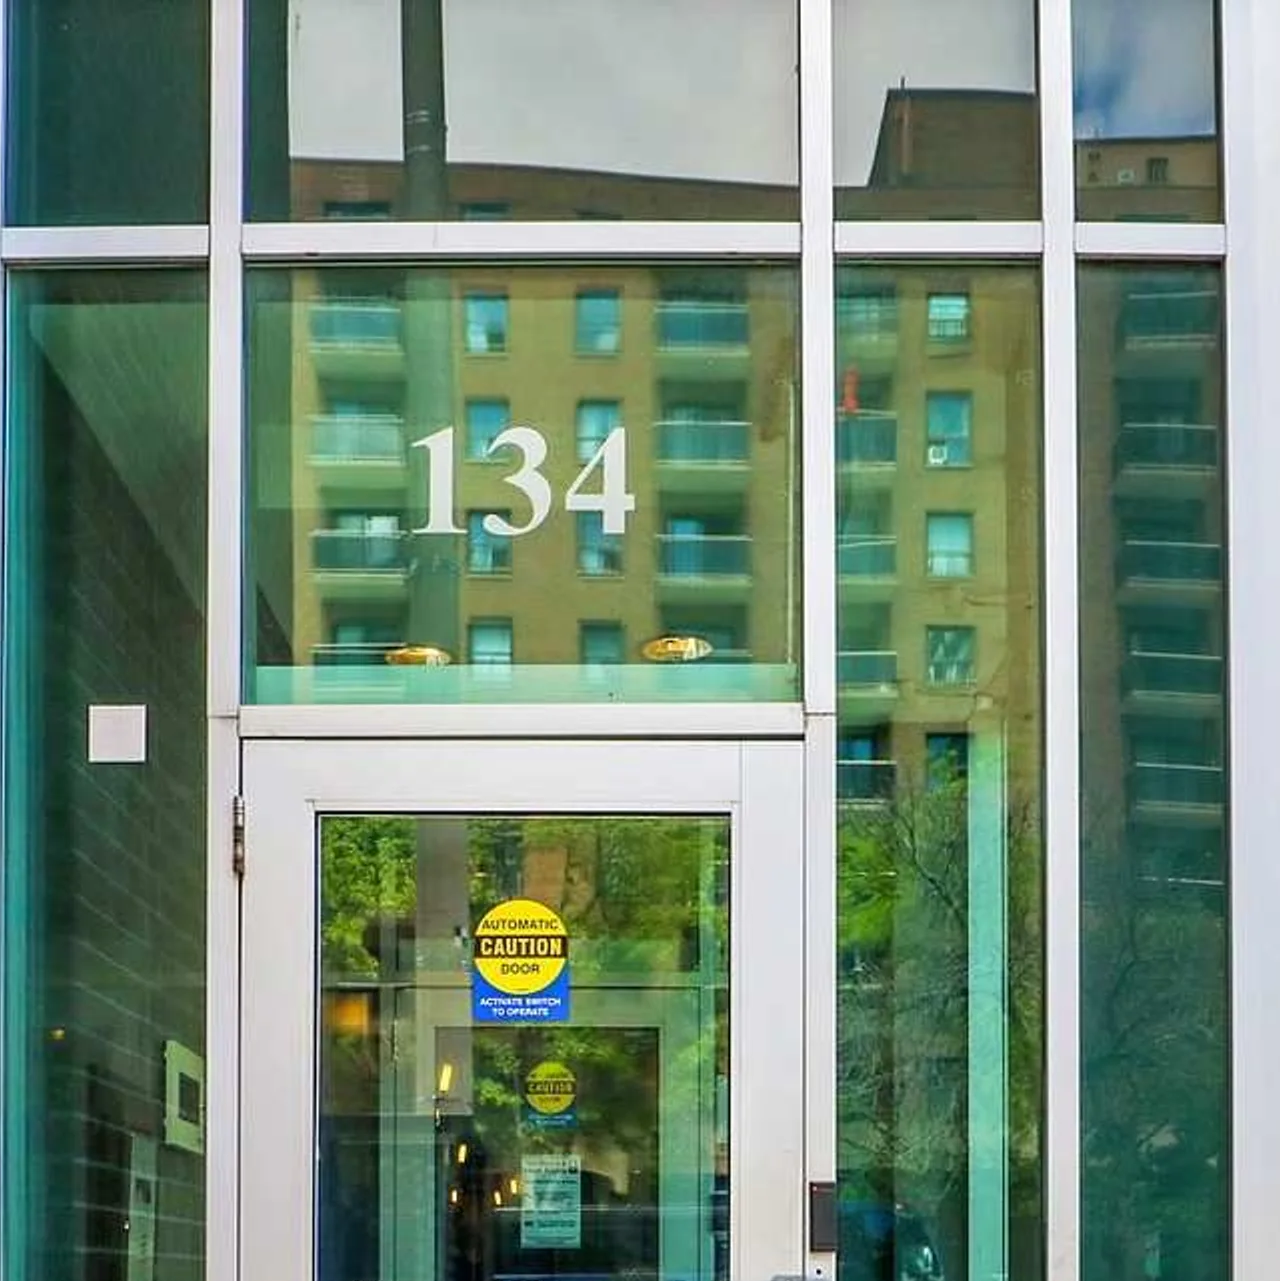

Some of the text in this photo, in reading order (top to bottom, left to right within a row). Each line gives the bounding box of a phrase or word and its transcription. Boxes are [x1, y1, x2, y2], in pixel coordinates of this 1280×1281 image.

[411, 426, 635, 535] 134
[482, 920, 558, 930] AUTOMATIC
[481, 938, 562, 956] CAUTION
[501, 963, 540, 975] DOOR
[492, 1008, 550, 1016] TO OPERATE
